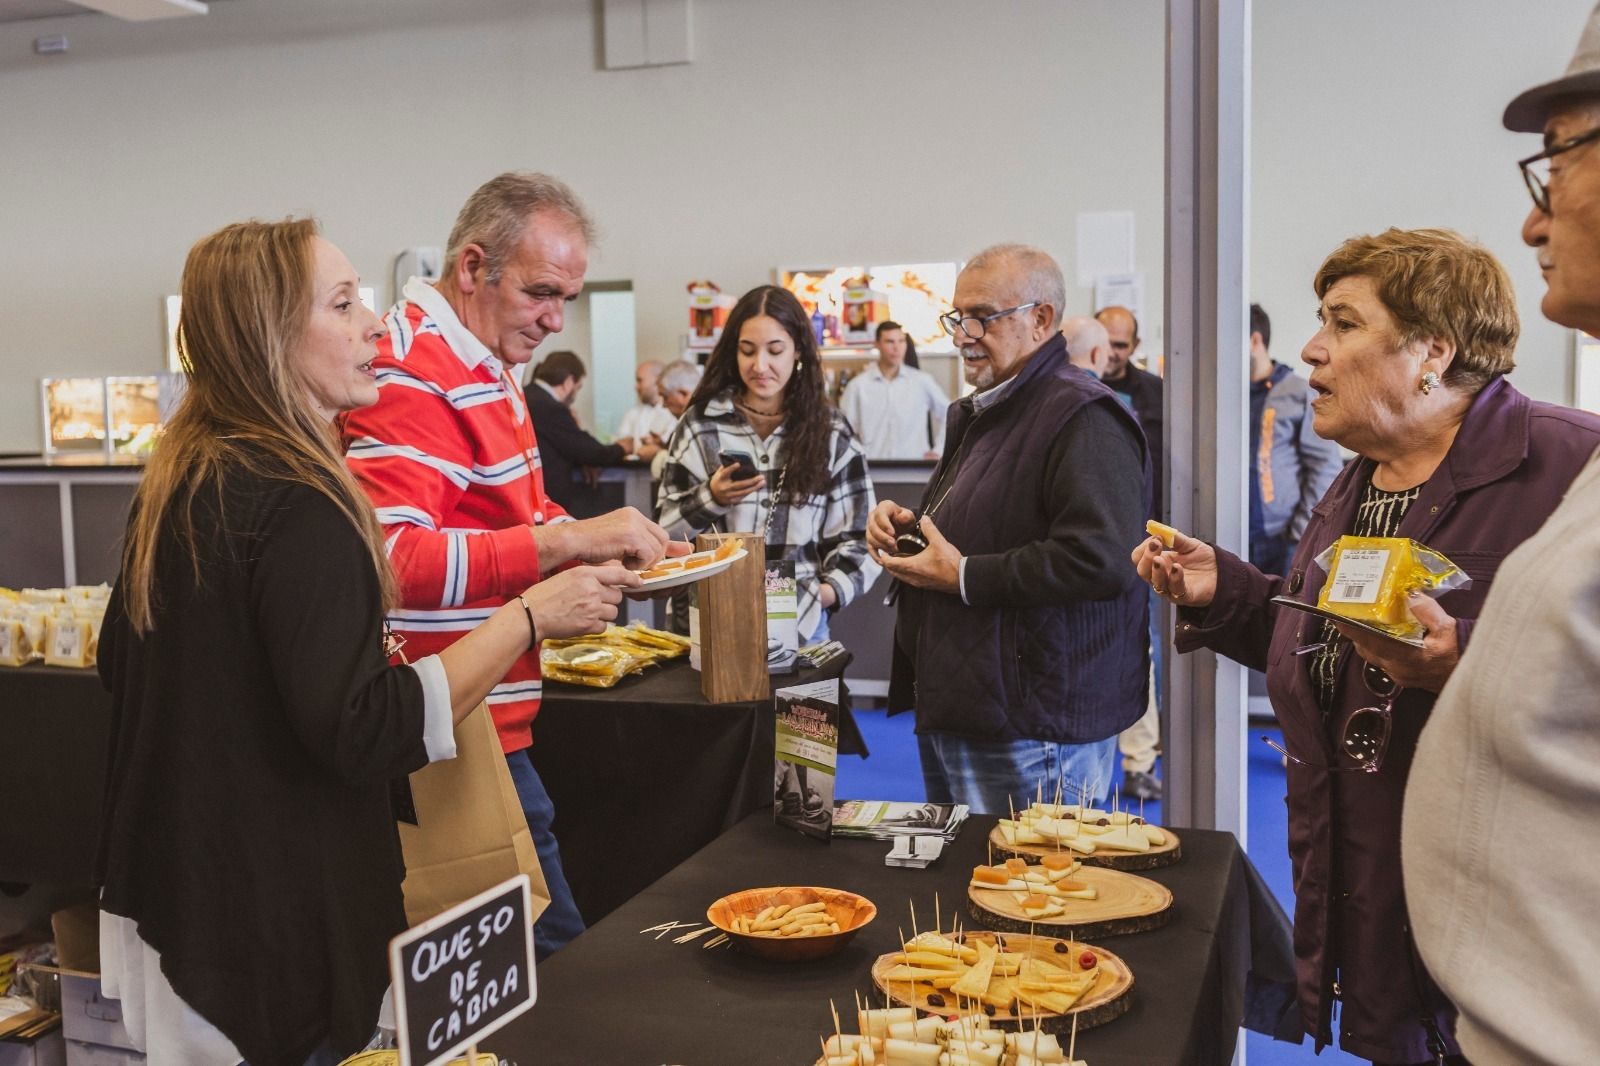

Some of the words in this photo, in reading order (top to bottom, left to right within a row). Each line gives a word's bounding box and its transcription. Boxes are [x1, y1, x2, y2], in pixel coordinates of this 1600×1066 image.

[411, 905, 514, 982] QUESO
[449, 960, 482, 1004] DE
[427, 964, 518, 1051] CABRA
